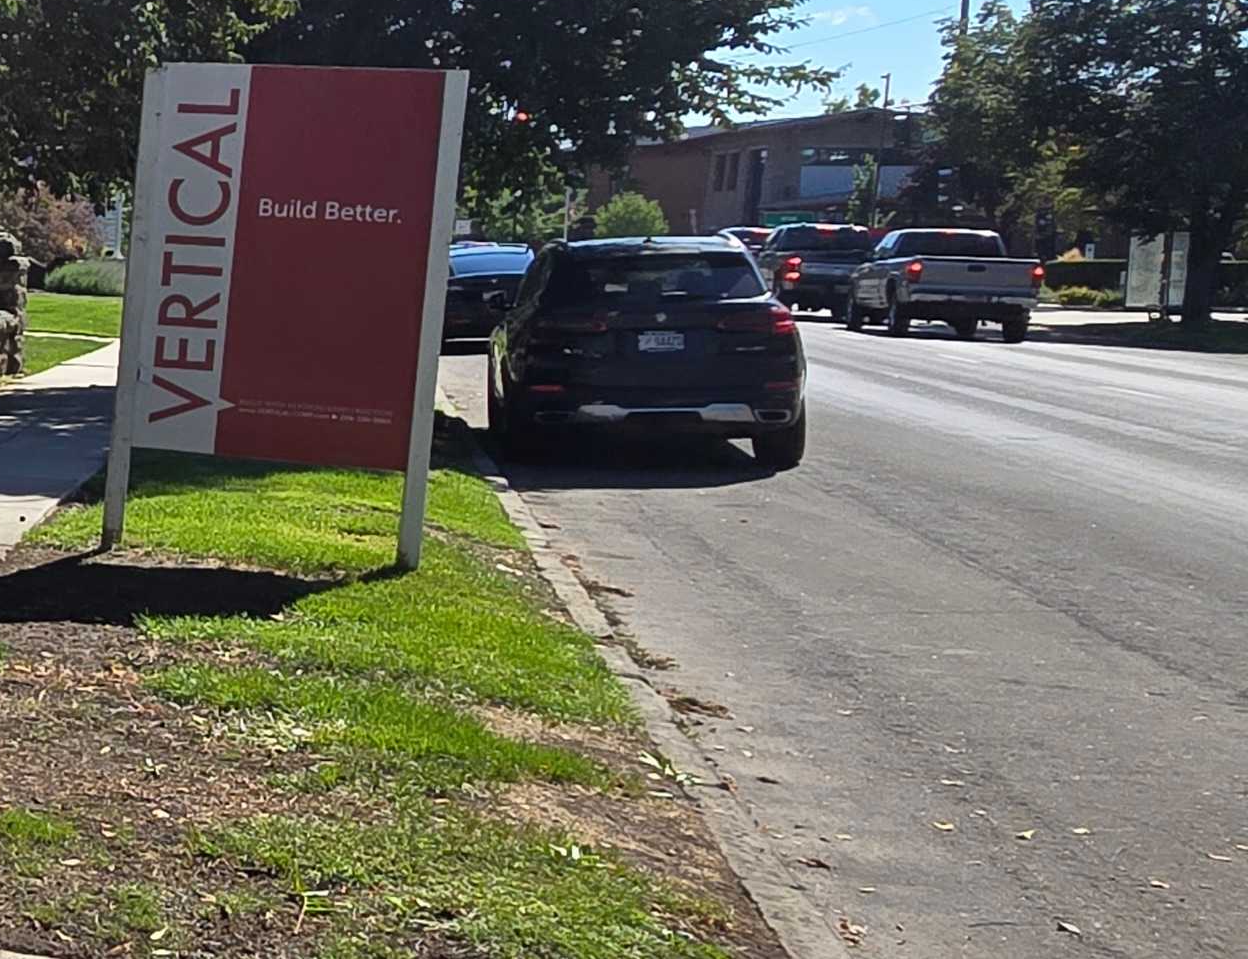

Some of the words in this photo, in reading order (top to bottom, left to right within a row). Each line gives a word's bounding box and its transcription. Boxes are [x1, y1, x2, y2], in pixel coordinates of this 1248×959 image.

[149, 88, 240, 422] VERTICAL
[258, 198, 317, 219] Build
[325, 201, 403, 224] Better.
